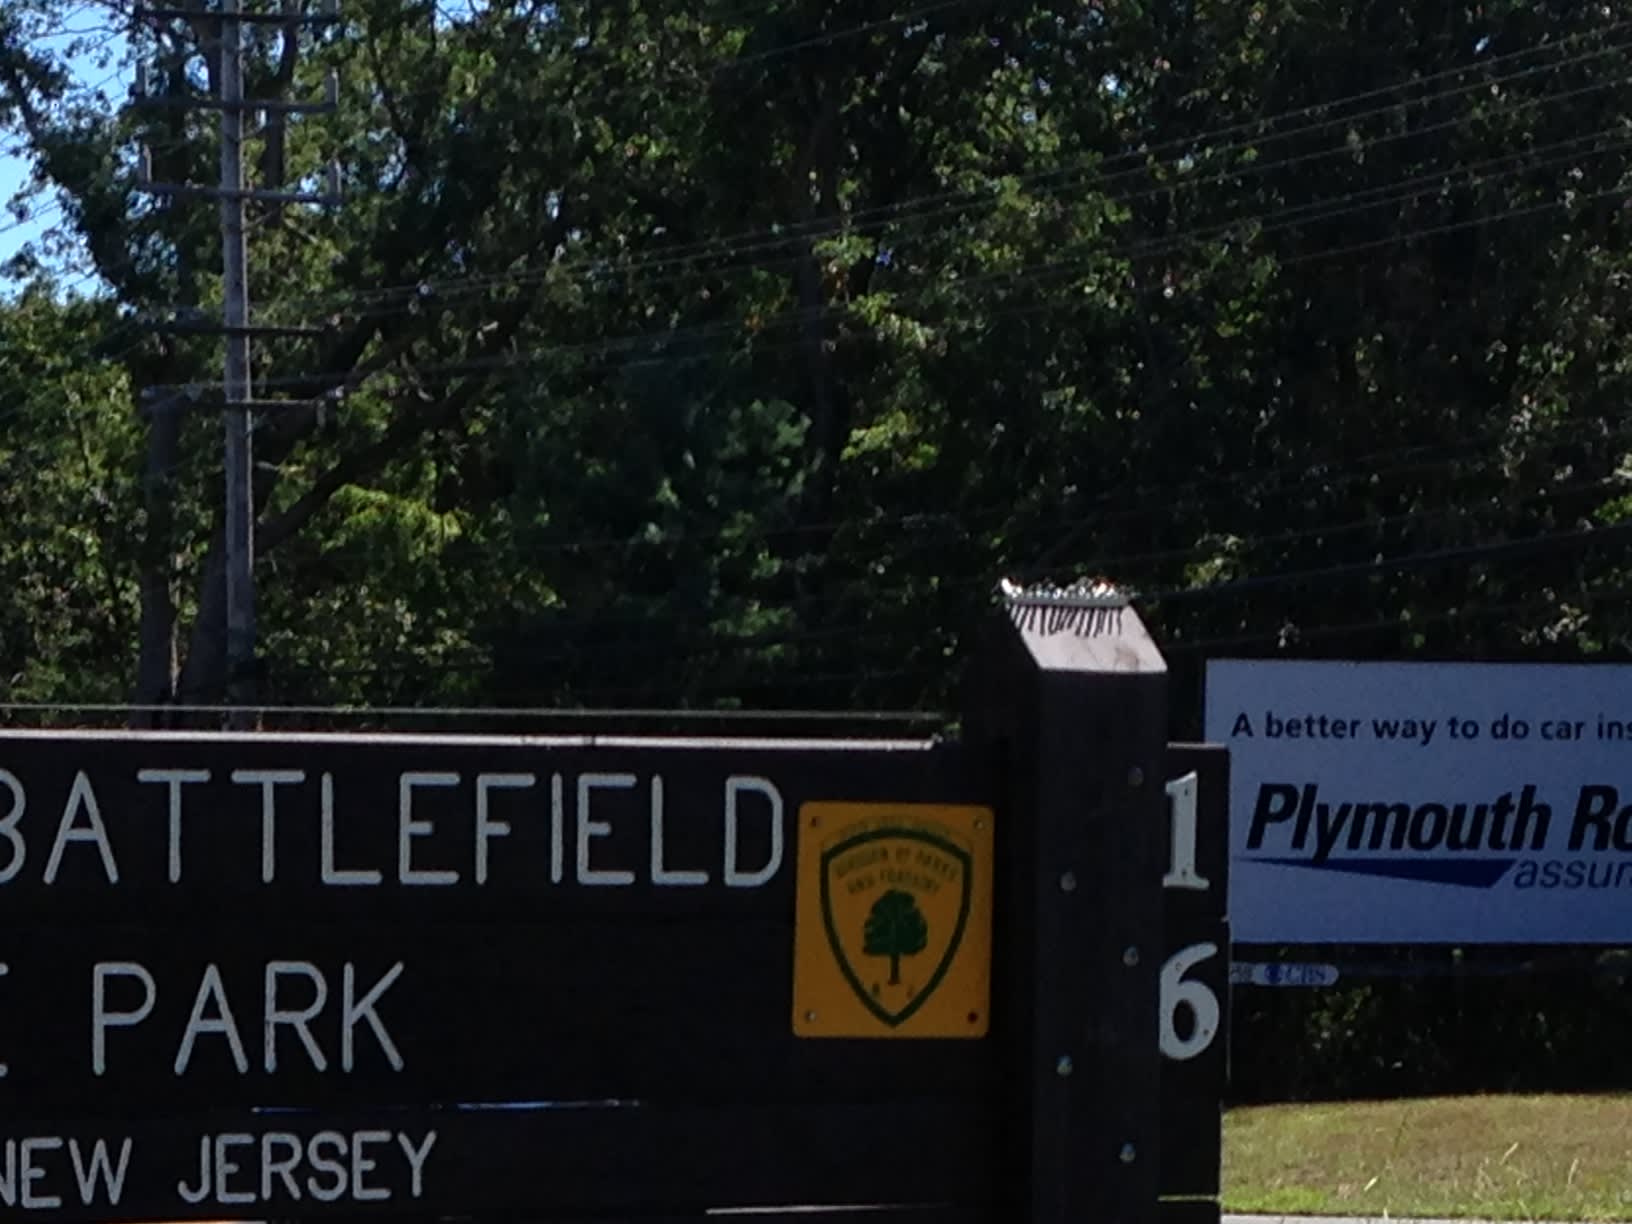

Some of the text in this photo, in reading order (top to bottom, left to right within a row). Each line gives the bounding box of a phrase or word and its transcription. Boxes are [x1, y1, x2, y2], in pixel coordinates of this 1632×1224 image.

[1231, 711, 1253, 737] A
[1265, 711, 1360, 739] better
[1372, 719, 1437, 746] way
[1447, 715, 1479, 740] to
[1490, 711, 1530, 740] do
[1540, 719, 1586, 740] car
[1246, 783, 1552, 864] Plymouth
[92, 960, 405, 1077] PARK
[177, 1129, 437, 1206] JERSEY
